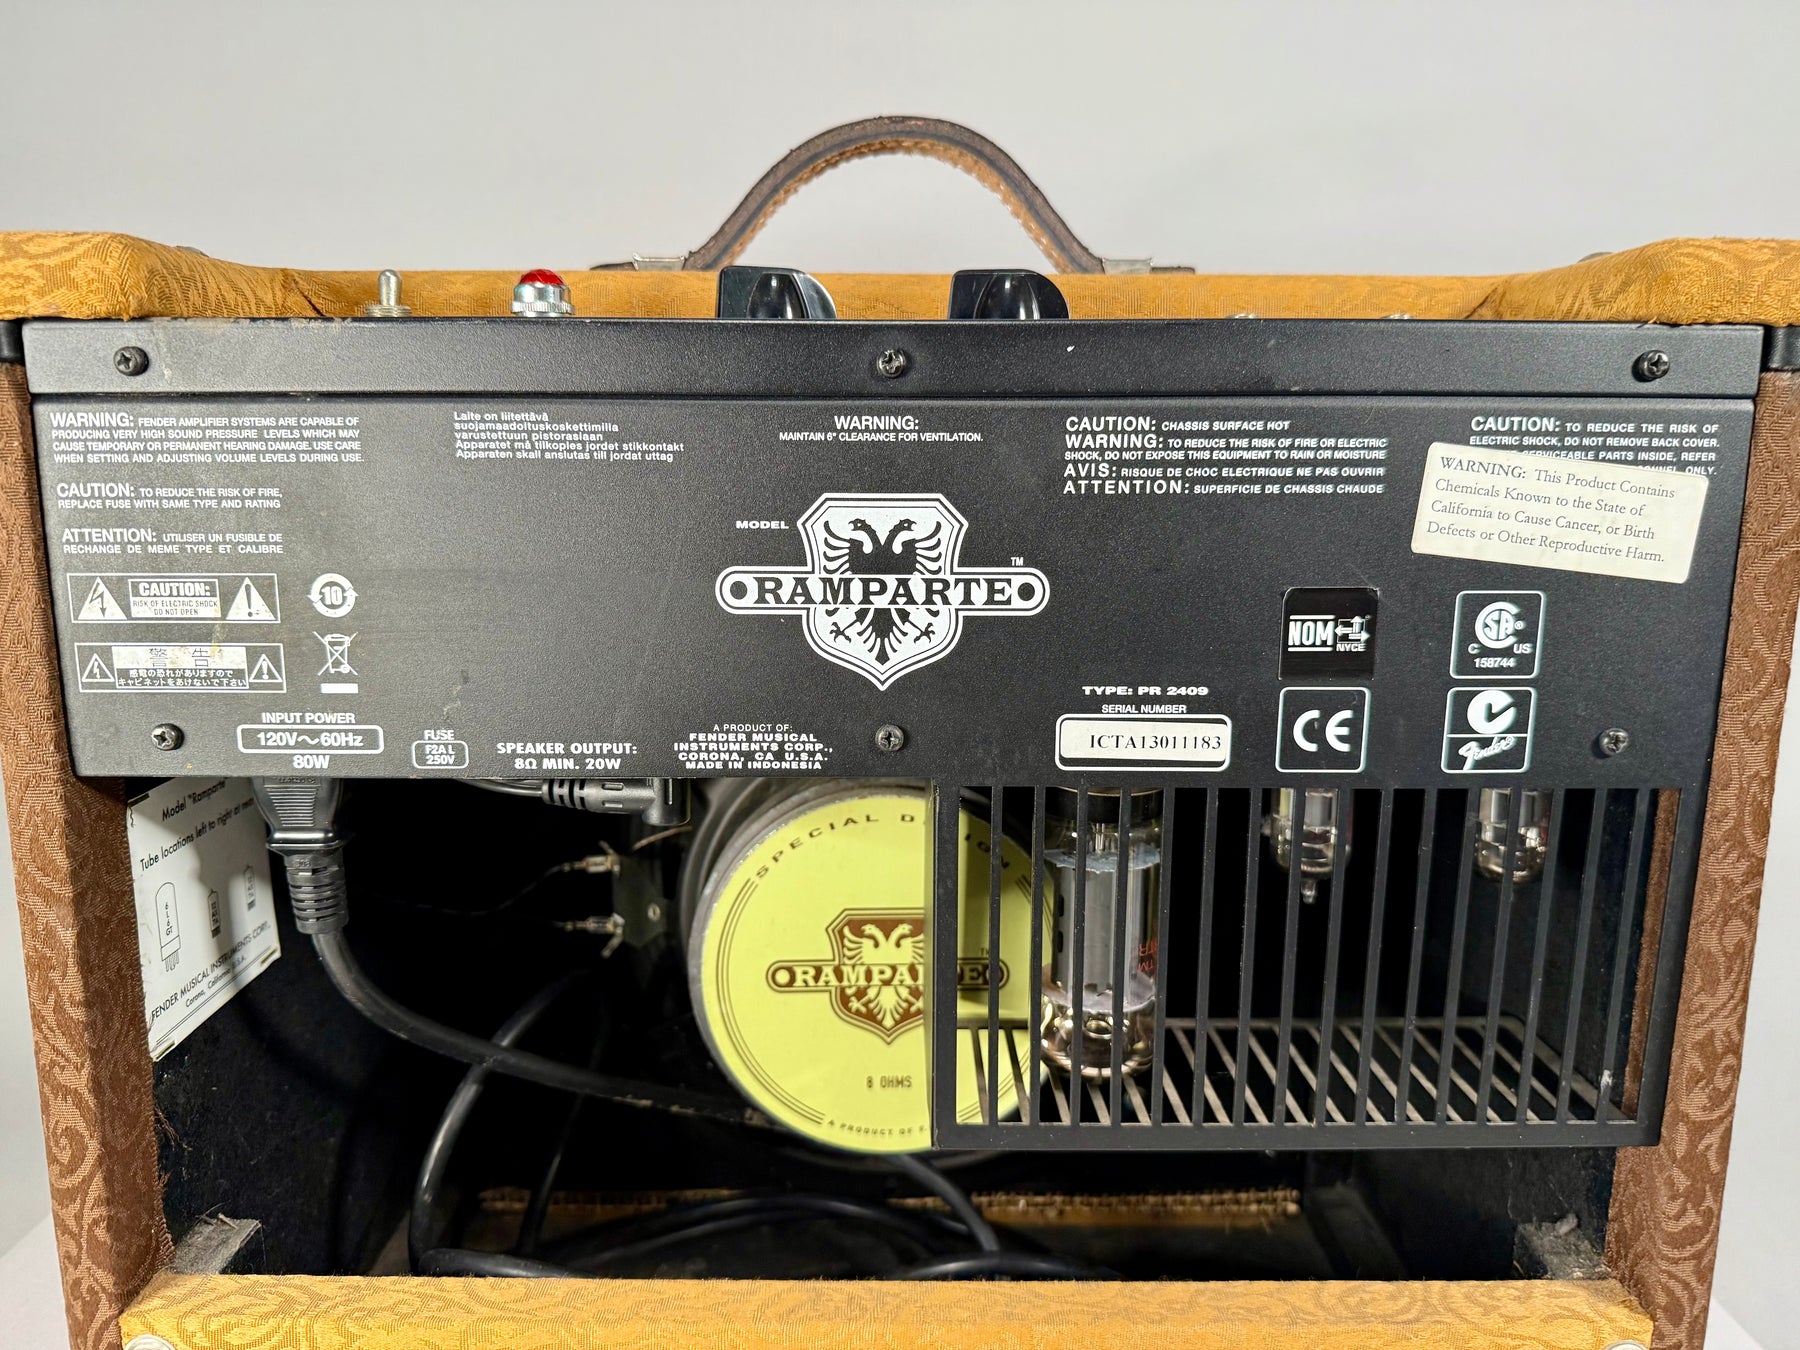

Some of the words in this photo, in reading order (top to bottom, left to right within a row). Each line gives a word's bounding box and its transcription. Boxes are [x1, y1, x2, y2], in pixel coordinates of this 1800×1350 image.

[50, 412, 134, 427] WARNING:
[138, 417, 176, 426] FENDER
[178, 417, 229, 426] AMPLIFIER
[230, 416, 276, 426] SYSTEMS
[278, 417, 298, 426] ARE
[299, 416, 344, 426] CAPABLE
[345, 416, 359, 425] OF
[834, 415, 918, 430] WARNING:
[1065, 416, 1156, 431] CAUTION:
[1161, 420, 1209, 430] CHASSIS
[1212, 420, 1264, 430] SURFACE
[1266, 420, 1290, 430] HOT
[1471, 416, 1560, 431] CAUTION:
[1564, 422, 1581, 431] TO
[1586, 422, 1635, 432] REDUCE
[1640, 423, 1663, 432] THE
[1669, 423, 1697, 433] RISK
[1702, 424, 1719, 433] OF
[51, 429, 110, 439] PRODUCING
[112, 429, 138, 439] VERY
[140, 429, 165, 438] HIGH
[167, 429, 202, 438] SOUND
[205, 429, 258, 438] PRESSURE
[263, 429, 300, 438] LEVELS
[301, 429, 336, 438] WHICH
[338, 429, 359, 438] MAY
[779, 431, 824, 440] MAINTAIN
[826, 431, 836, 440] 6"
[838, 432, 896, 441] CLEARANCE
[898, 432, 918, 441] FOR
[1065, 433, 1163, 448] WARNING:
[1167, 438, 1182, 448] TO
[1184, 438, 1226, 447] REDUCE
[1228, 438, 1249, 447] THE
[1251, 438, 1276, 447] RISK
[1277, 438, 1292, 447] OF
[1294, 438, 1318, 447] FIRE
[1319, 438, 1336, 447] OR
[1337, 438, 1387, 447] ELECTRIC
[1598, 451, 1634, 460] PARTS
[1637, 451, 1676, 461] INSIDE,
[1680, 451, 1716, 460] REFER
[1063, 462, 1116, 477] AVIS:
[1440, 456, 1526, 478] WARNING:
[1534, 468, 1561, 483] This
[1566, 473, 1616, 490] Product
[1619, 480, 1674, 498] Contains
[56, 482, 134, 497] CAUTION:
[138, 487, 153, 497] TO
[155, 487, 194, 497] REDUCE
[196, 487, 216, 496] THE
[217, 487, 241, 496] RISK
[242, 487, 256, 496] OF
[257, 487, 282, 497] FIRE,
[1063, 479, 1189, 494] ATTENTION:
[1193, 484, 1261, 493] SUPERFICIE
[1264, 484, 1280, 493] DE
[1283, 484, 1334, 493] CHASSIS
[1336, 484, 1383, 493] CHAUDE
[57, 499, 103, 508] REPLACE
[105, 499, 131, 508] FUSE
[133, 499, 159, 508] WITH
[161, 499, 190, 508] SAME
[192, 499, 218, 508] TYPE
[221, 499, 242, 508] AND
[244, 499, 280, 508] RATING
[1435, 479, 1499, 497] Chemicals
[1504, 487, 1550, 504] Known
[1555, 496, 1568, 506] to
[1572, 495, 1592, 509] the
[1595, 498, 1625, 513] State
[1629, 504, 1646, 516] of
[735, 520, 789, 529] MODEL
[1431, 500, 1492, 518] California
[1497, 511, 1510, 520] to
[1514, 510, 1551, 526] Cause
[1555, 515, 1601, 533] Cancer,
[1605, 525, 1620, 534] or
[1623, 524, 1654, 539] Birth
[61, 527, 156, 542] ATTENTION:
[1427, 520, 1475, 537] Defects
[1479, 531, 1494, 540] or
[1497, 530, 1535, 545] Other
[1538, 535, 1622, 556] Reproductive
[1625, 546, 1664, 561] Harm.
[138, 582, 210, 597] CAUTION:
[324, 588, 342, 605] 10
[753, 577, 1011, 605] RAMPARTE
[1288, 621, 1335, 646] NOM
[1336, 643, 1367, 652] NYCE
[1513, 643, 1533, 655] US
[1473, 657, 1517, 668] 158744
[1082, 685, 1133, 695] TYPE:
[1137, 686, 1161, 695] PR
[1166, 686, 1208, 695] 2409
[1101, 704, 1138, 714] SERIAL
[1140, 704, 1186, 714] NUMBER
[261, 712, 302, 723] INPUT
[304, 712, 355, 723] POWER
[713, 723, 719, 731] A
[723, 723, 772, 731] PRODUCT
[775, 723, 792, 731] OF:
[1293, 709, 1353, 753] CE
[424, 729, 454, 741] FUSE
[689, 732, 746, 741] FENDER
[752, 732, 817, 741] MUSICAL
[1090, 734, 1220, 749] ICTA13011183
[496, 742, 564, 754] SPEAKER
[570, 742, 637, 754] OUTPUT:
[673, 742, 778, 753] INSTRUMENTS
[784, 742, 832, 753] CORP.,
[292, 754, 330, 768] 80W
[425, 754, 455, 764] 250V
[514, 757, 537, 769] 8Ω
[542, 757, 579, 769] MIN.
[585, 758, 621, 769] 20W
[678, 752, 744, 762] CORONA,
[754, 752, 774, 762] CA
[784, 752, 828, 762] U.S.A.
[685, 761, 723, 769] MADE
[728, 760, 742, 768] IN
[747, 761, 821, 769] INDONESIA
[162, 796, 187, 821] Model
[140, 851, 159, 872] Tube
[161, 834, 194, 859] locations
[756, 814, 879, 878] SPECIAL
[151, 992, 179, 1021] FENDER
[180, 968, 210, 999] MUSICAL
